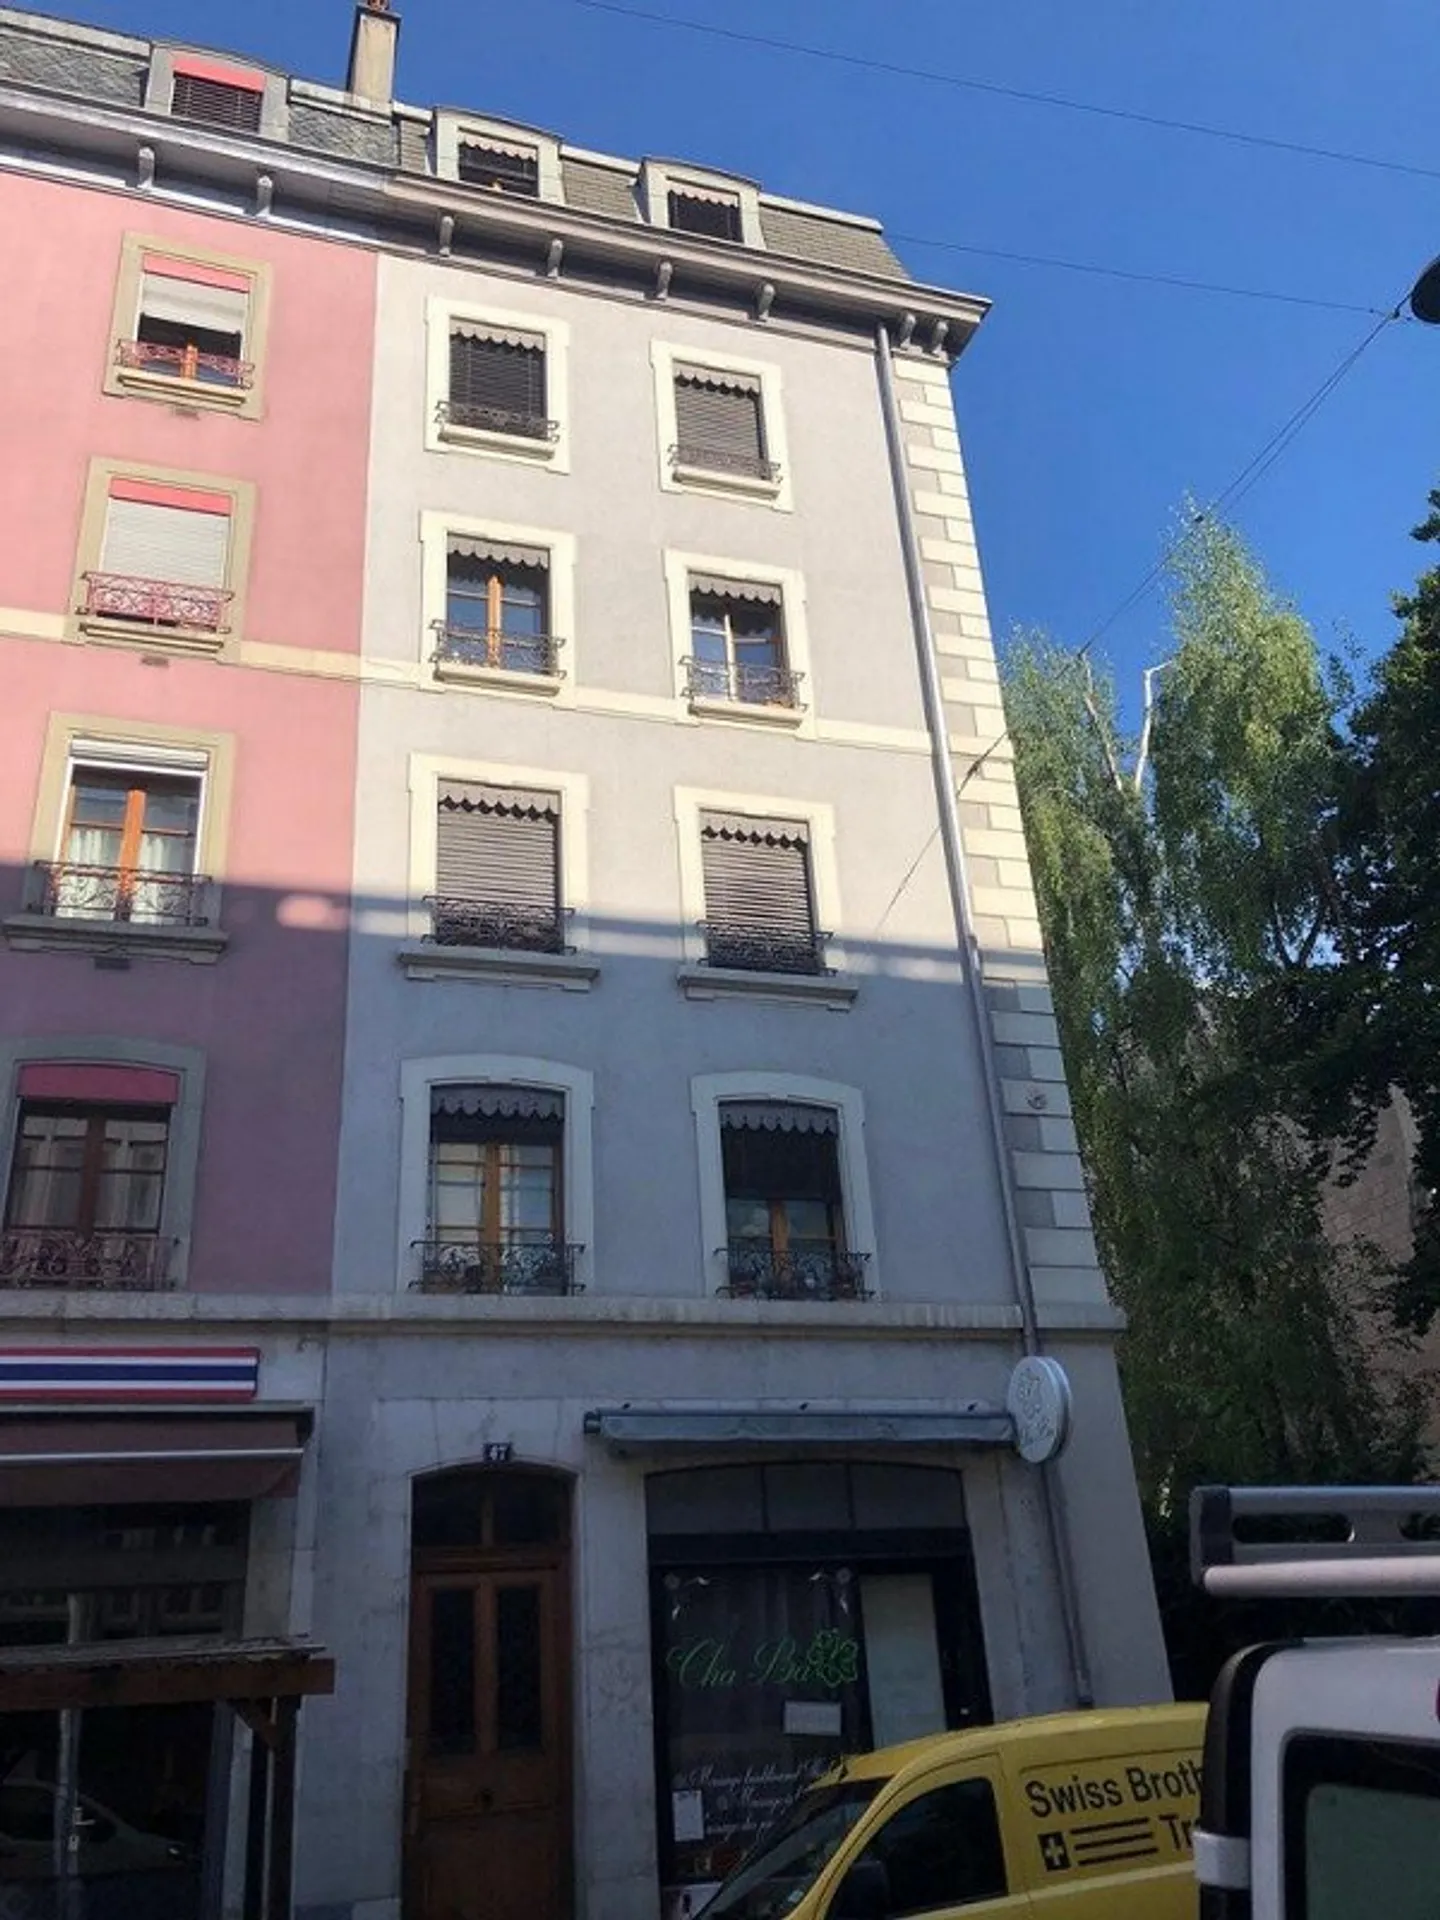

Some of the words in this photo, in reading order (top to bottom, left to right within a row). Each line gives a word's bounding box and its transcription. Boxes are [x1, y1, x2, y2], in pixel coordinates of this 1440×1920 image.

[490, 1445, 507, 1461] 47
[666, 1637, 738, 1689] Cha
[1025, 1774, 1124, 1818] Swiss
[1157, 1812, 1200, 1850] Tr
